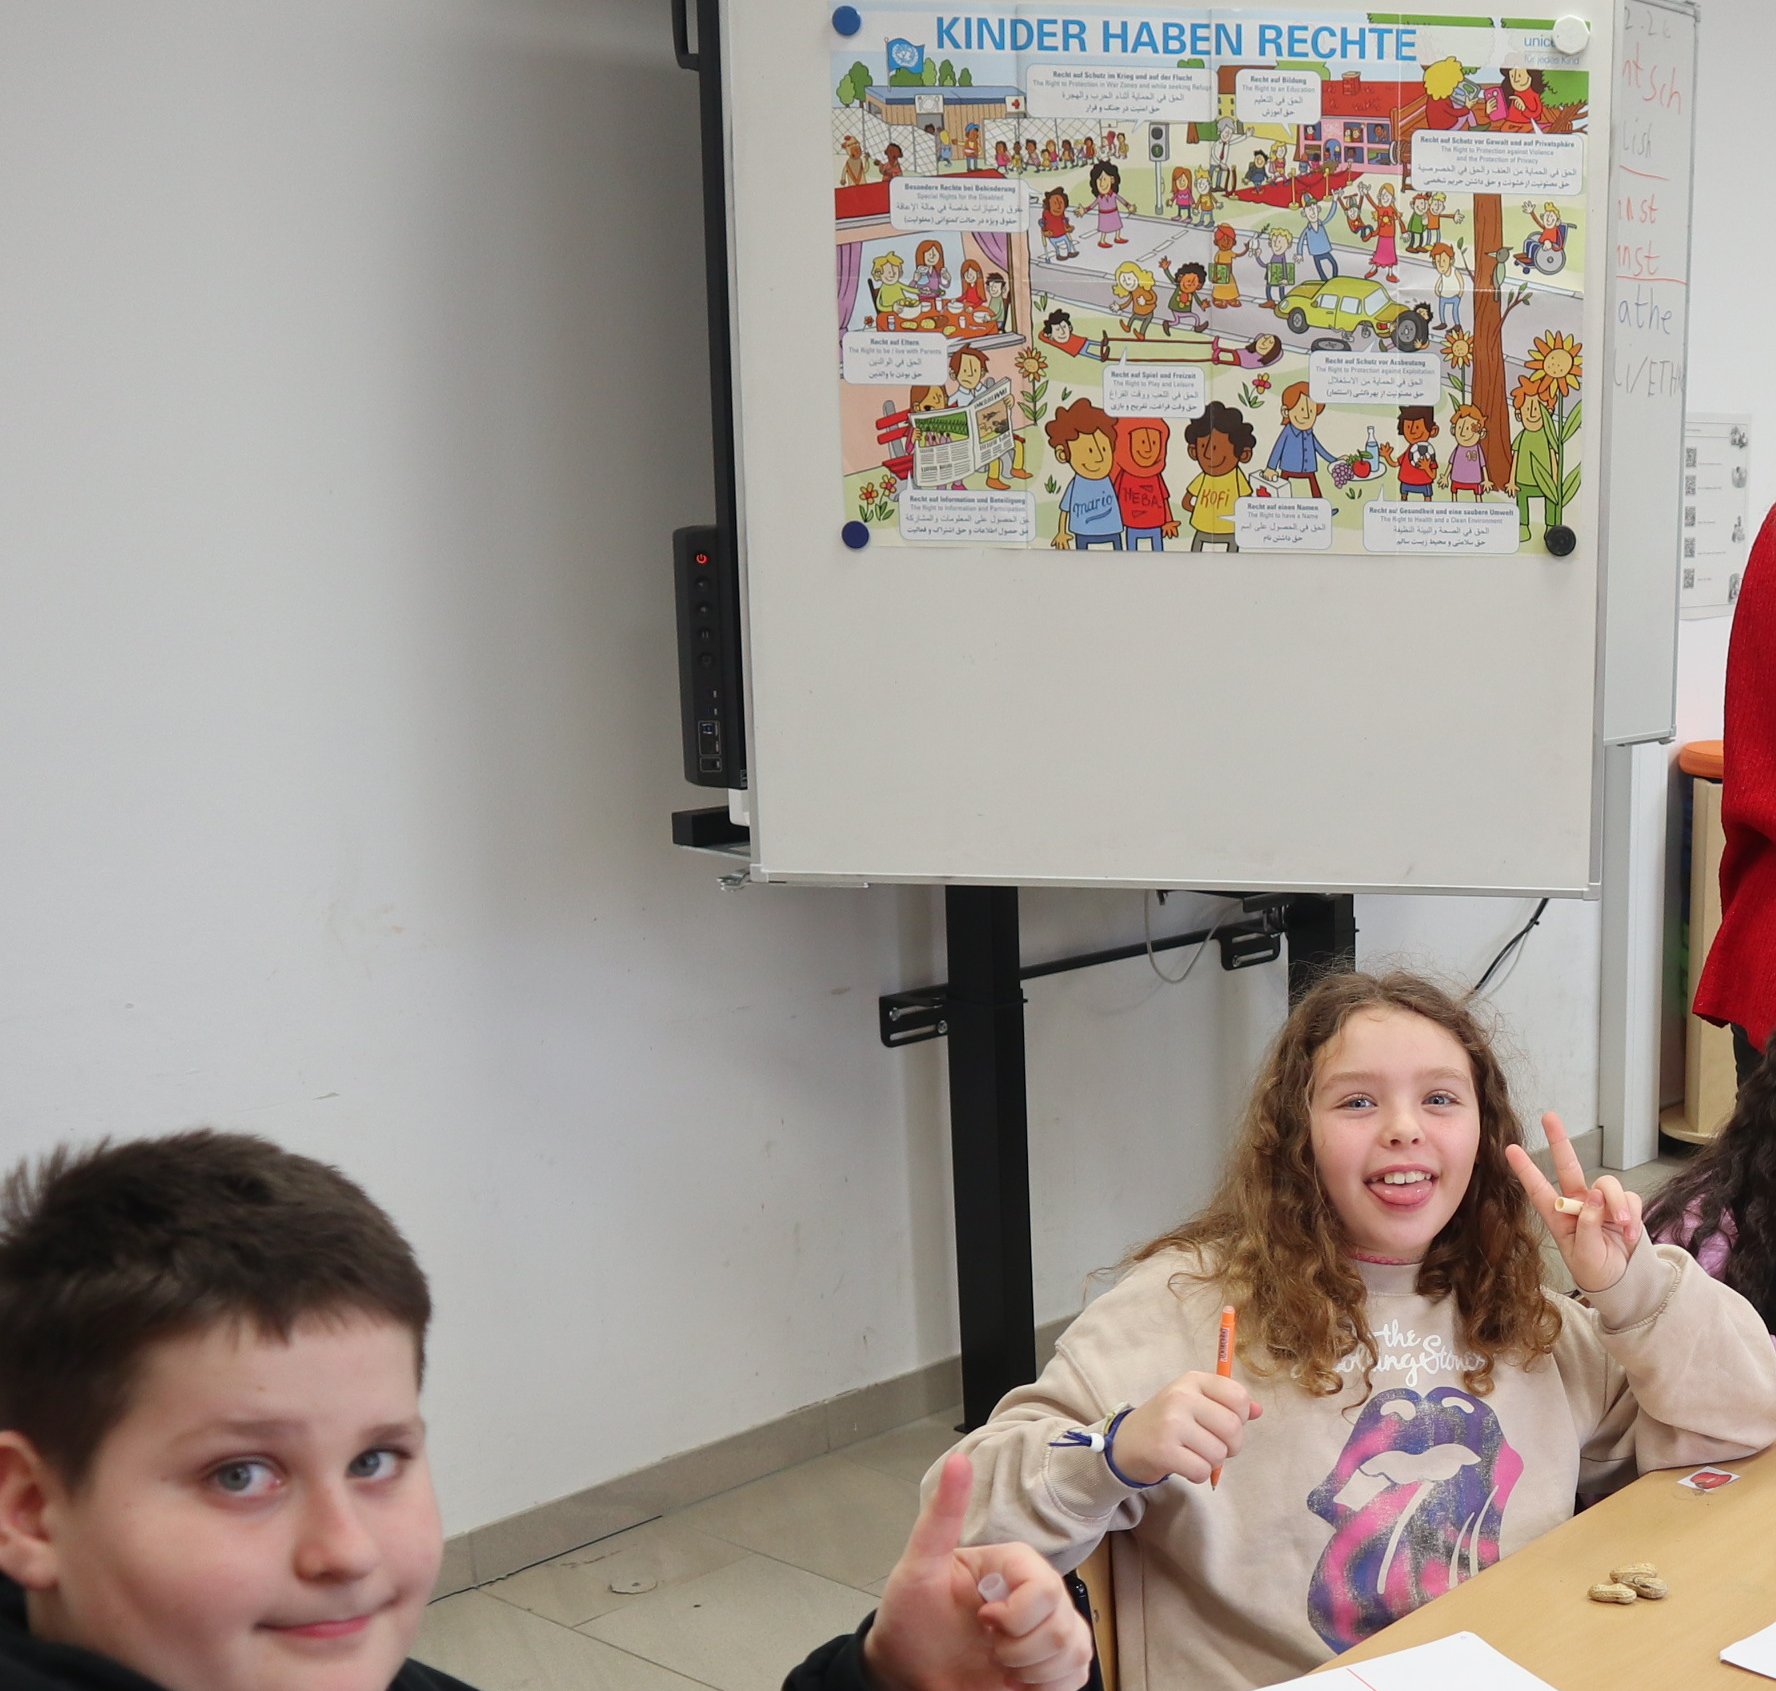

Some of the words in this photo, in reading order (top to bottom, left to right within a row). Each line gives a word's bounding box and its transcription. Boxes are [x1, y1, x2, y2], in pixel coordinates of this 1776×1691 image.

[936, 16, 1087, 52] KINDER
[1102, 20, 1242, 56] HABEN
[1258, 25, 1418, 61] RECHTE
[1053, 70, 1072, 78] Recht
[1073, 71, 1083, 79] auf
[1084, 72, 1106, 80] Schutz
[1117, 72, 1133, 82] Krieg
[1136, 73, 1147, 81] und
[1150, 73, 1160, 81] auf
[1173, 74, 1192, 82] Flucht
[1282, 76, 1307, 85] Bildung
[1510, 138, 1522, 146] und
[1524, 138, 1533, 146] auf
[1535, 139, 1574, 148] Privatsphäre
[905, 183, 938, 191] Besondere
[964, 184, 973, 192] bei
[975, 184, 1016, 194] Behinderung
[1142, 371, 1158, 379] Spiel
[990, 496, 1026, 505] Beteiligung
[1368, 1318, 1421, 1348] the
